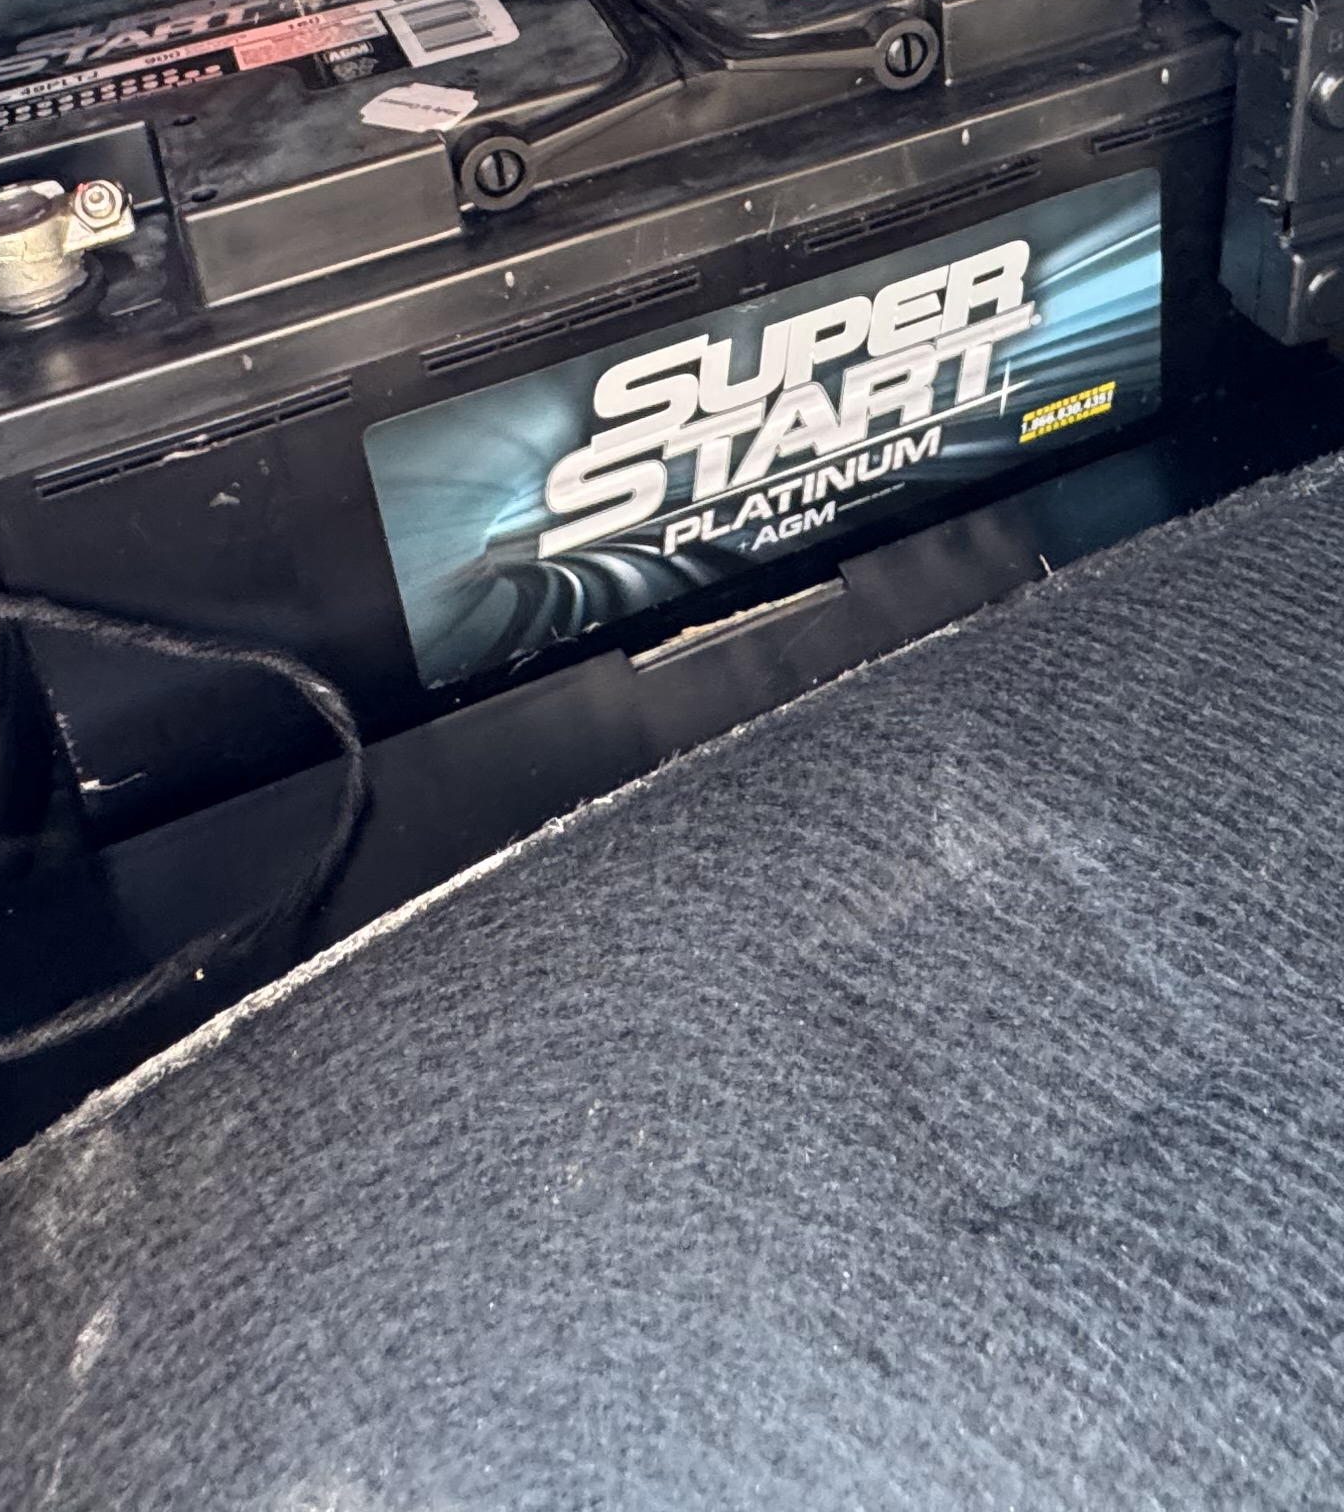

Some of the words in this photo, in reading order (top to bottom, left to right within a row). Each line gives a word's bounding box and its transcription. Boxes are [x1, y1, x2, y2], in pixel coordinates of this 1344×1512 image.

[592, 239, 1030, 420] SUPER
[538, 302, 1035, 560] START
[662, 425, 943, 557] PLATINUM
[751, 500, 837, 552] AGM
